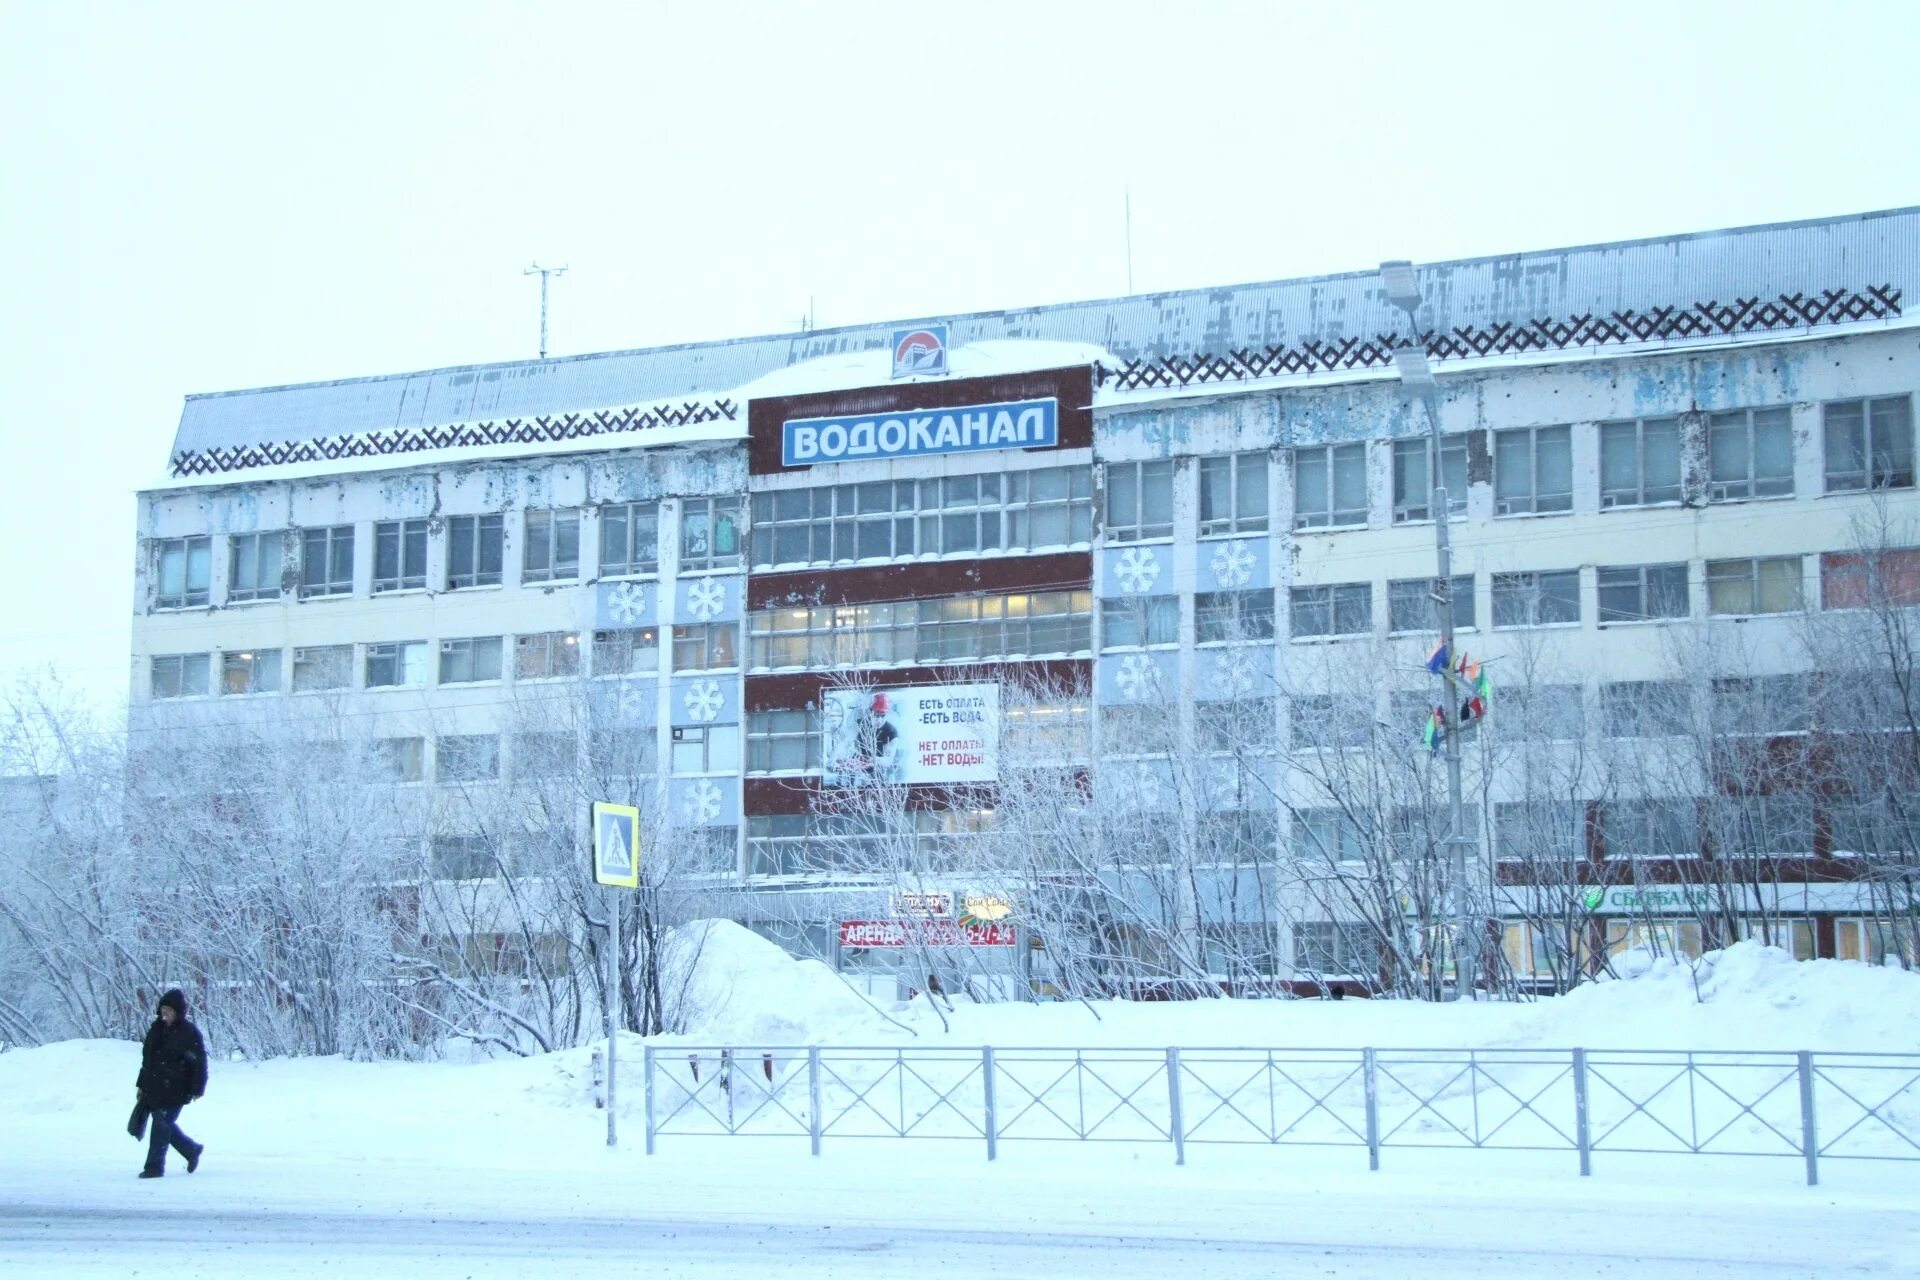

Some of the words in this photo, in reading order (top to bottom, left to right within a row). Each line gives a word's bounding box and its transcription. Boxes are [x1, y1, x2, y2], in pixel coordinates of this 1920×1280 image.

[793, 406, 1045, 460] ВОДОКАНАЛ
[919, 699, 943, 710] ЕСТЬ
[946, 697, 986, 709] ОПЛАТА
[918, 740, 938, 752] НЕТ
[947, 752, 985, 767] ВОДЫ!
